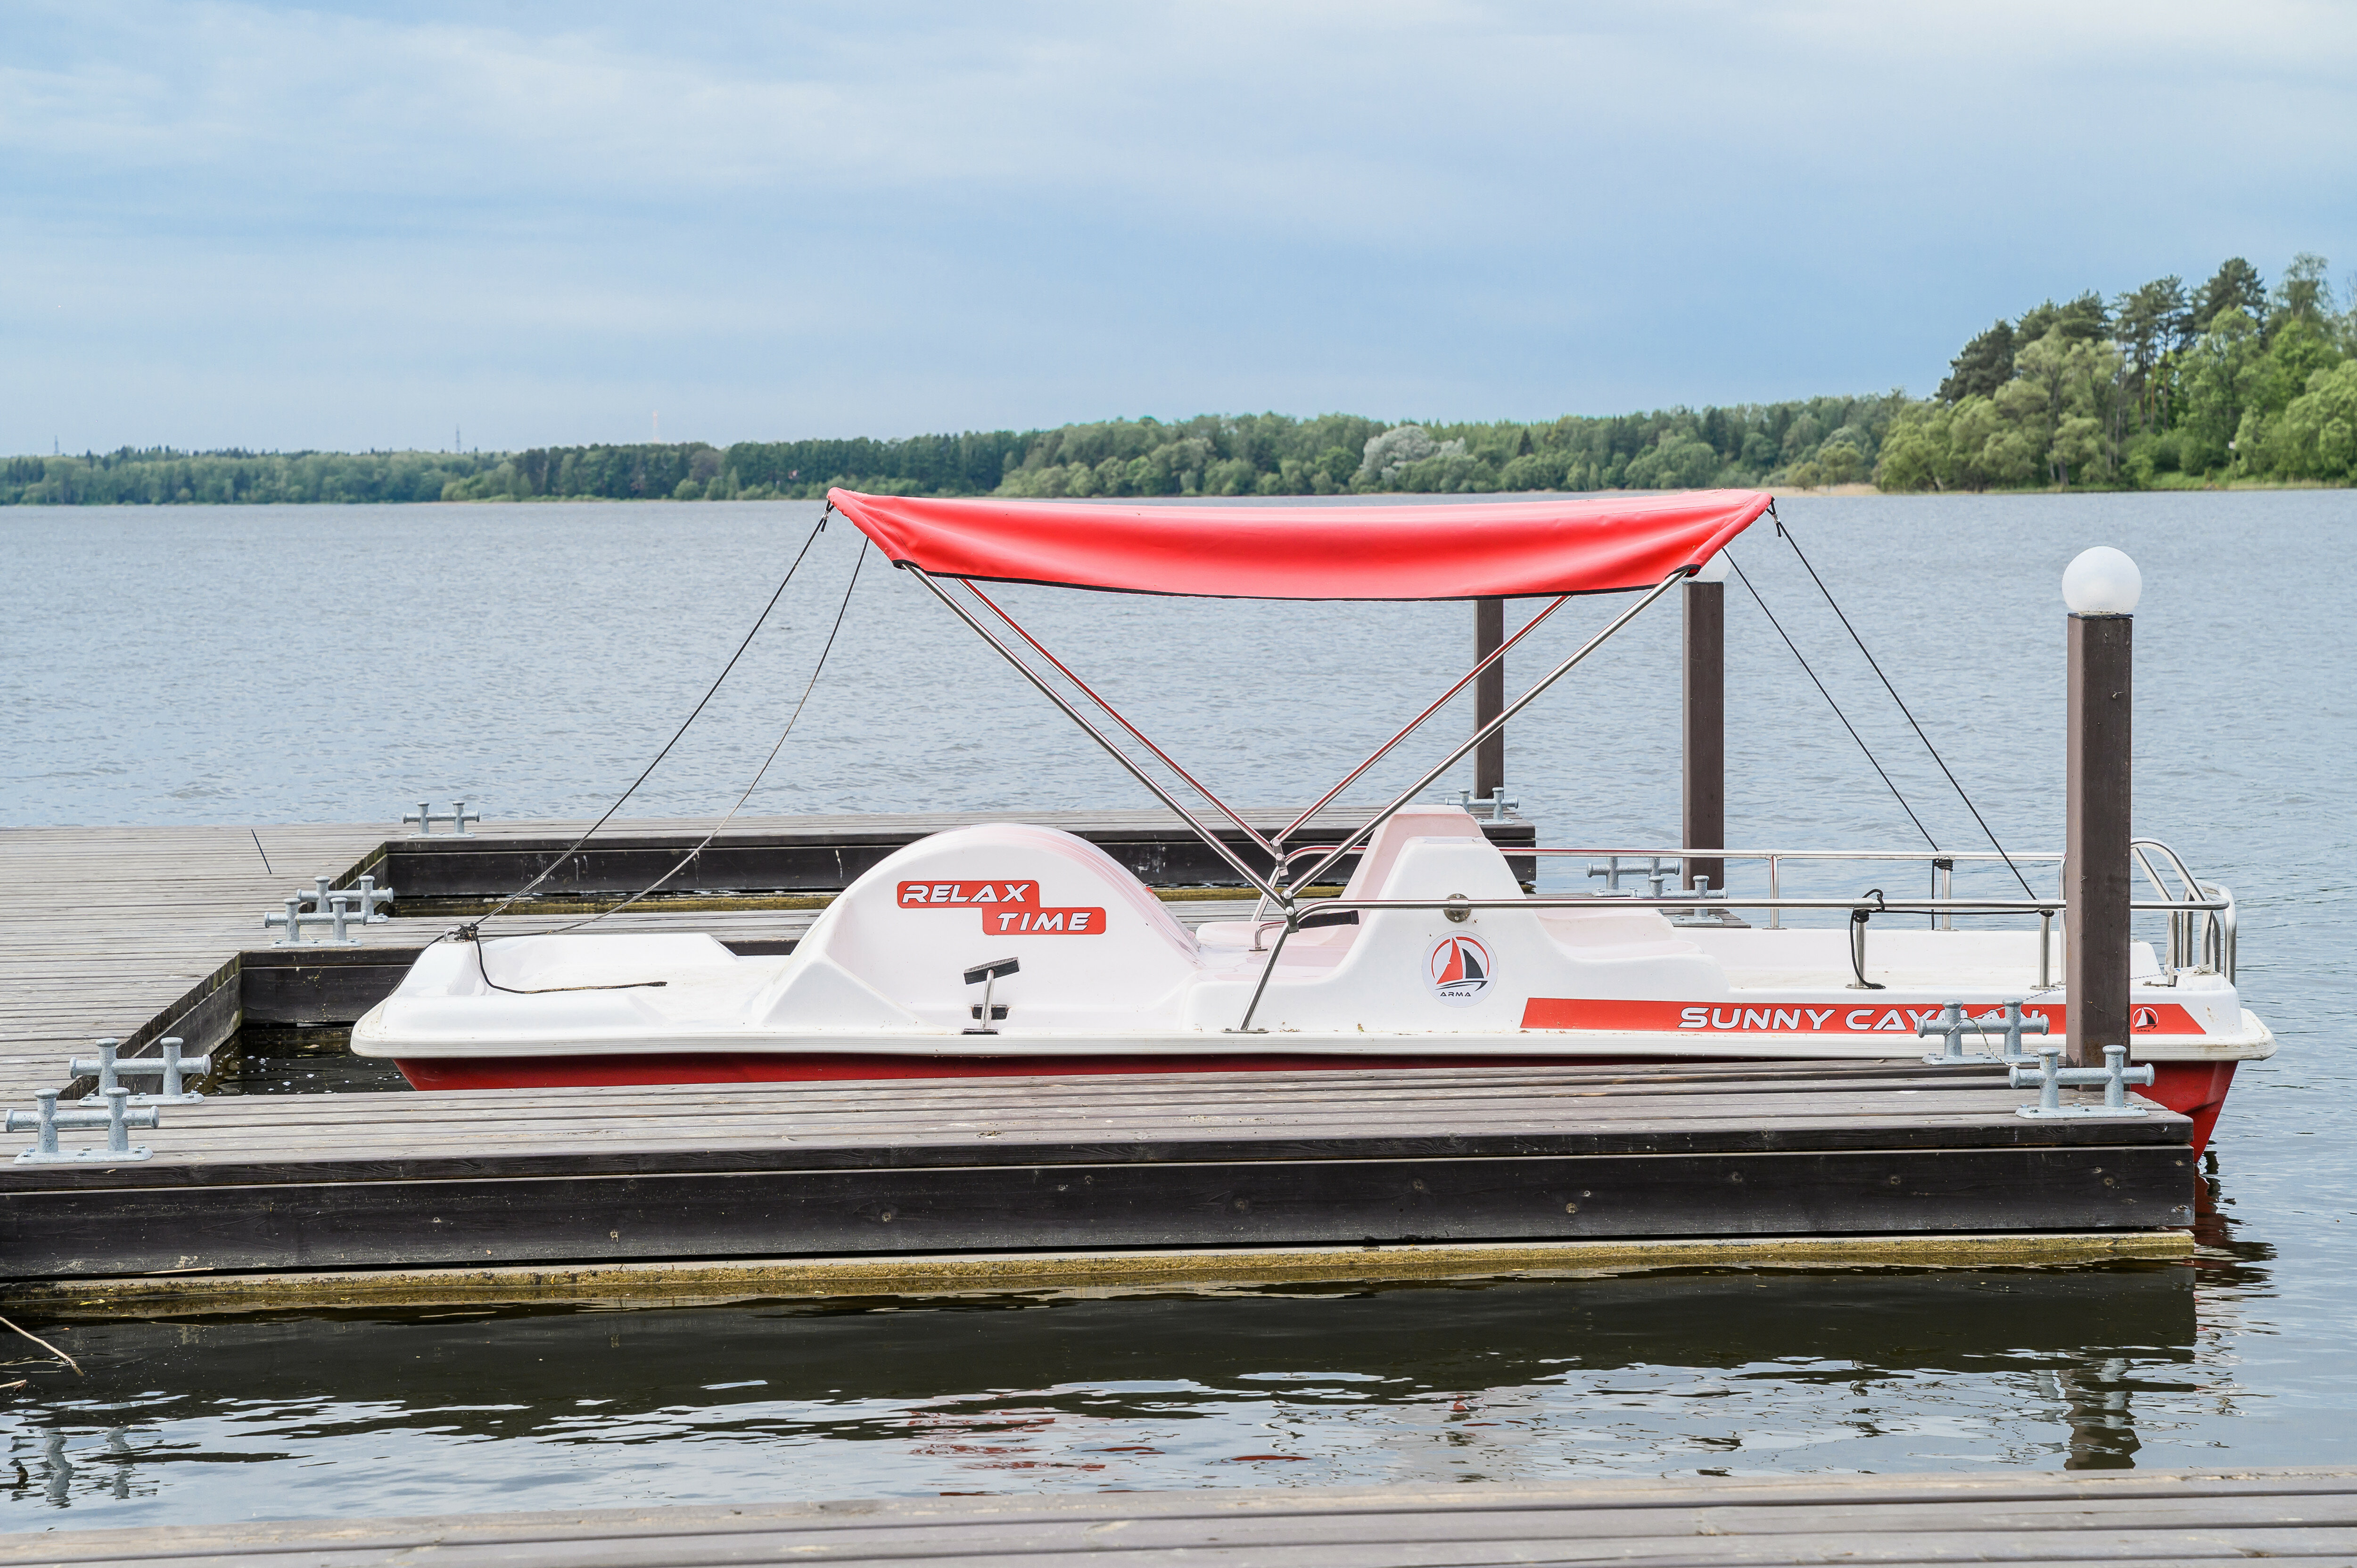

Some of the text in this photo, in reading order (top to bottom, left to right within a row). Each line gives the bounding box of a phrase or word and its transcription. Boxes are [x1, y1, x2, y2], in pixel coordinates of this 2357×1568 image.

[902, 884, 1030, 903] RELAX
[997, 912, 1092, 931] TIME
[1678, 1007, 1837, 1030] SUNNY
